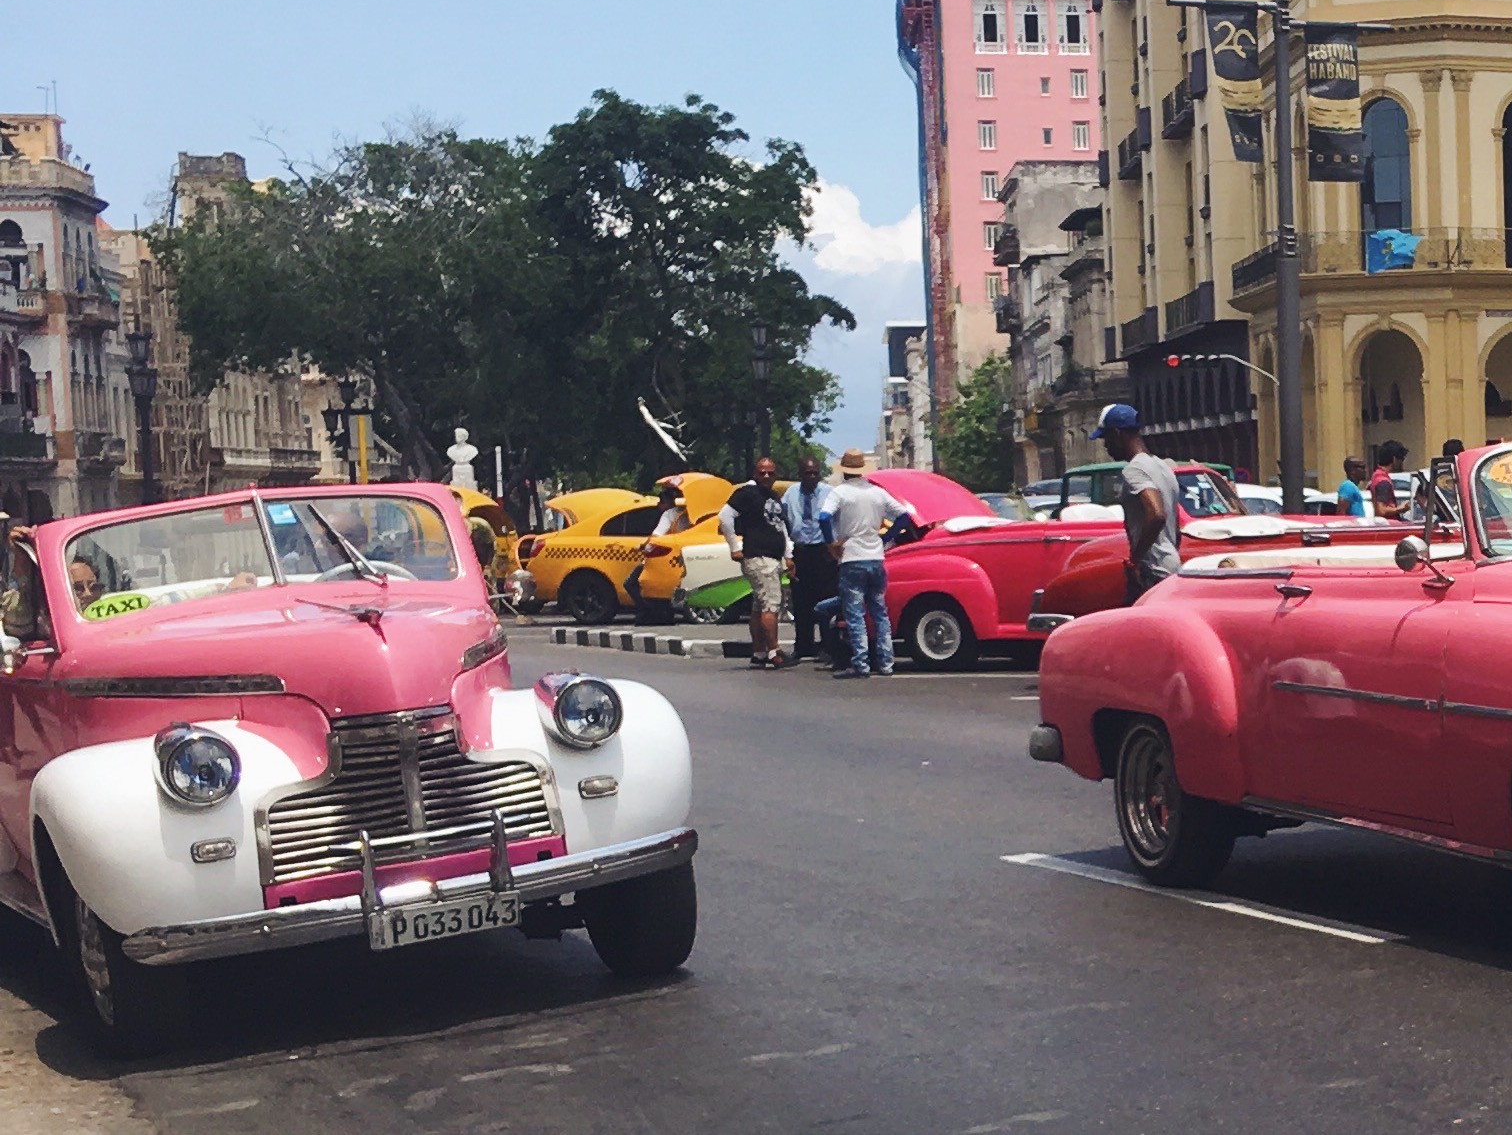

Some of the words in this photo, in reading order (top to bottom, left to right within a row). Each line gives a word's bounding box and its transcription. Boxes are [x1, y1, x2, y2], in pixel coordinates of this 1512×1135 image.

[1307, 43, 1356, 62] FESTIVAL
[1309, 62, 1357, 81] HABANO
[91, 597, 144, 618] TAXI
